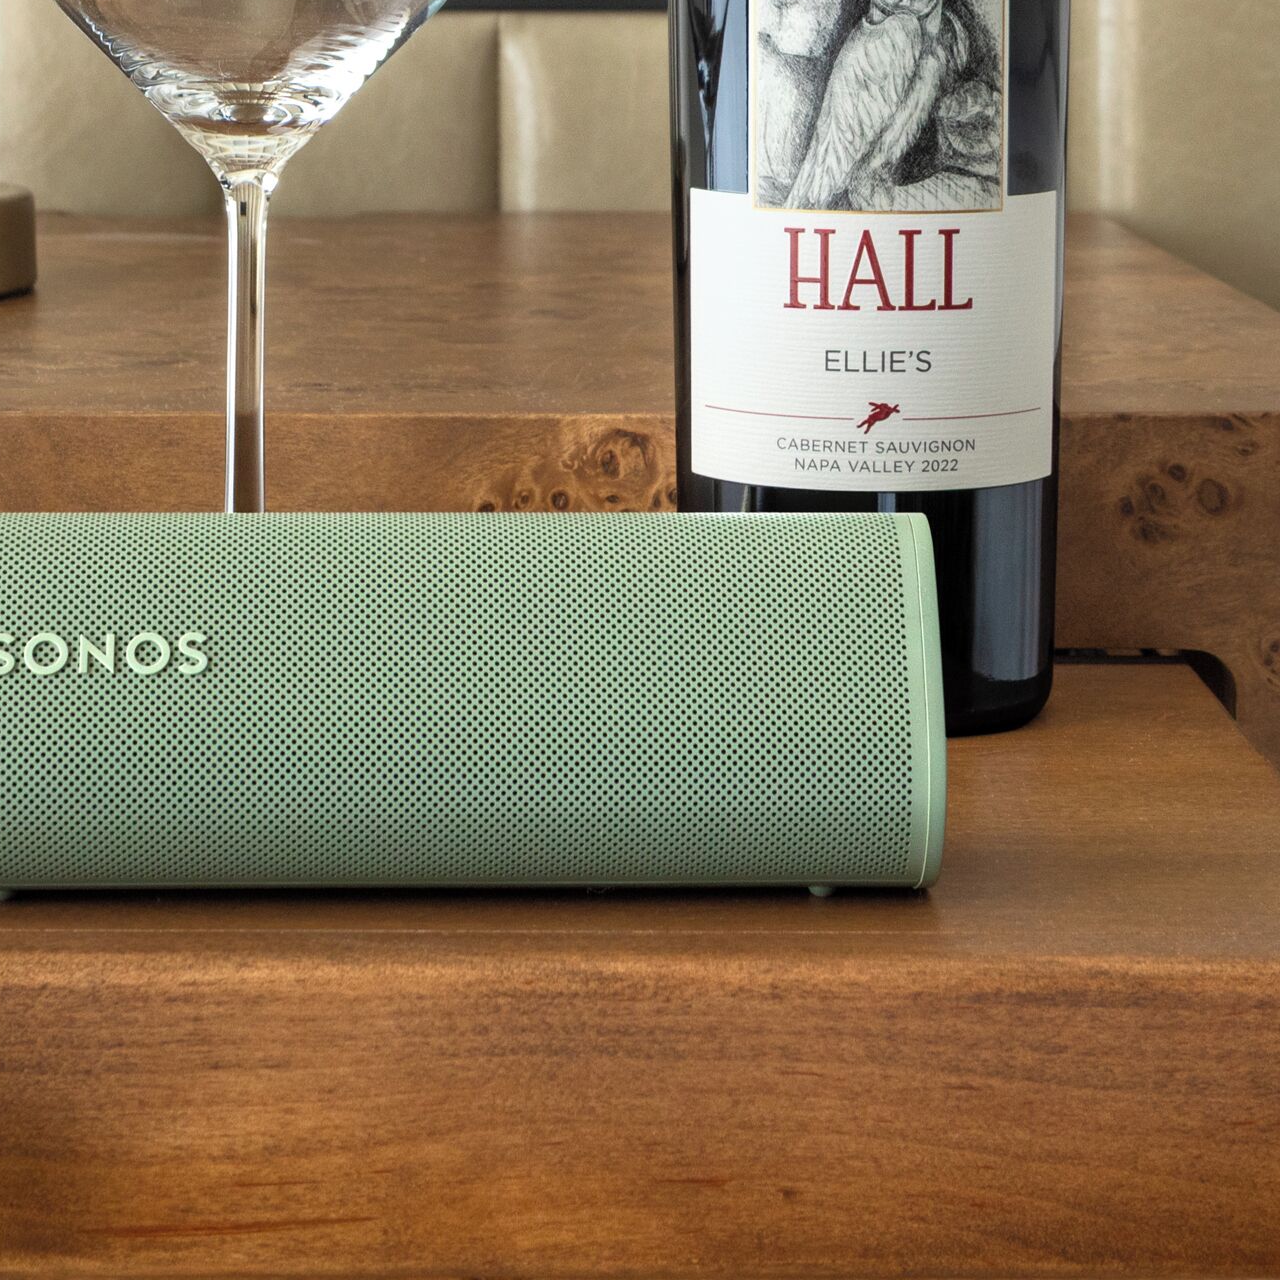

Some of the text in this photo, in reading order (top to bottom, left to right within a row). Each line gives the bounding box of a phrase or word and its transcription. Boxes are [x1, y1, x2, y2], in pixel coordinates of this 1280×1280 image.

[783, 227, 973, 311] HALL
[824, 350, 932, 372] ELLIE’S
[776, 436, 976, 454] CABERNET SAUVIGNON
[794, 457, 959, 474] NAPA VALLEY 2022
